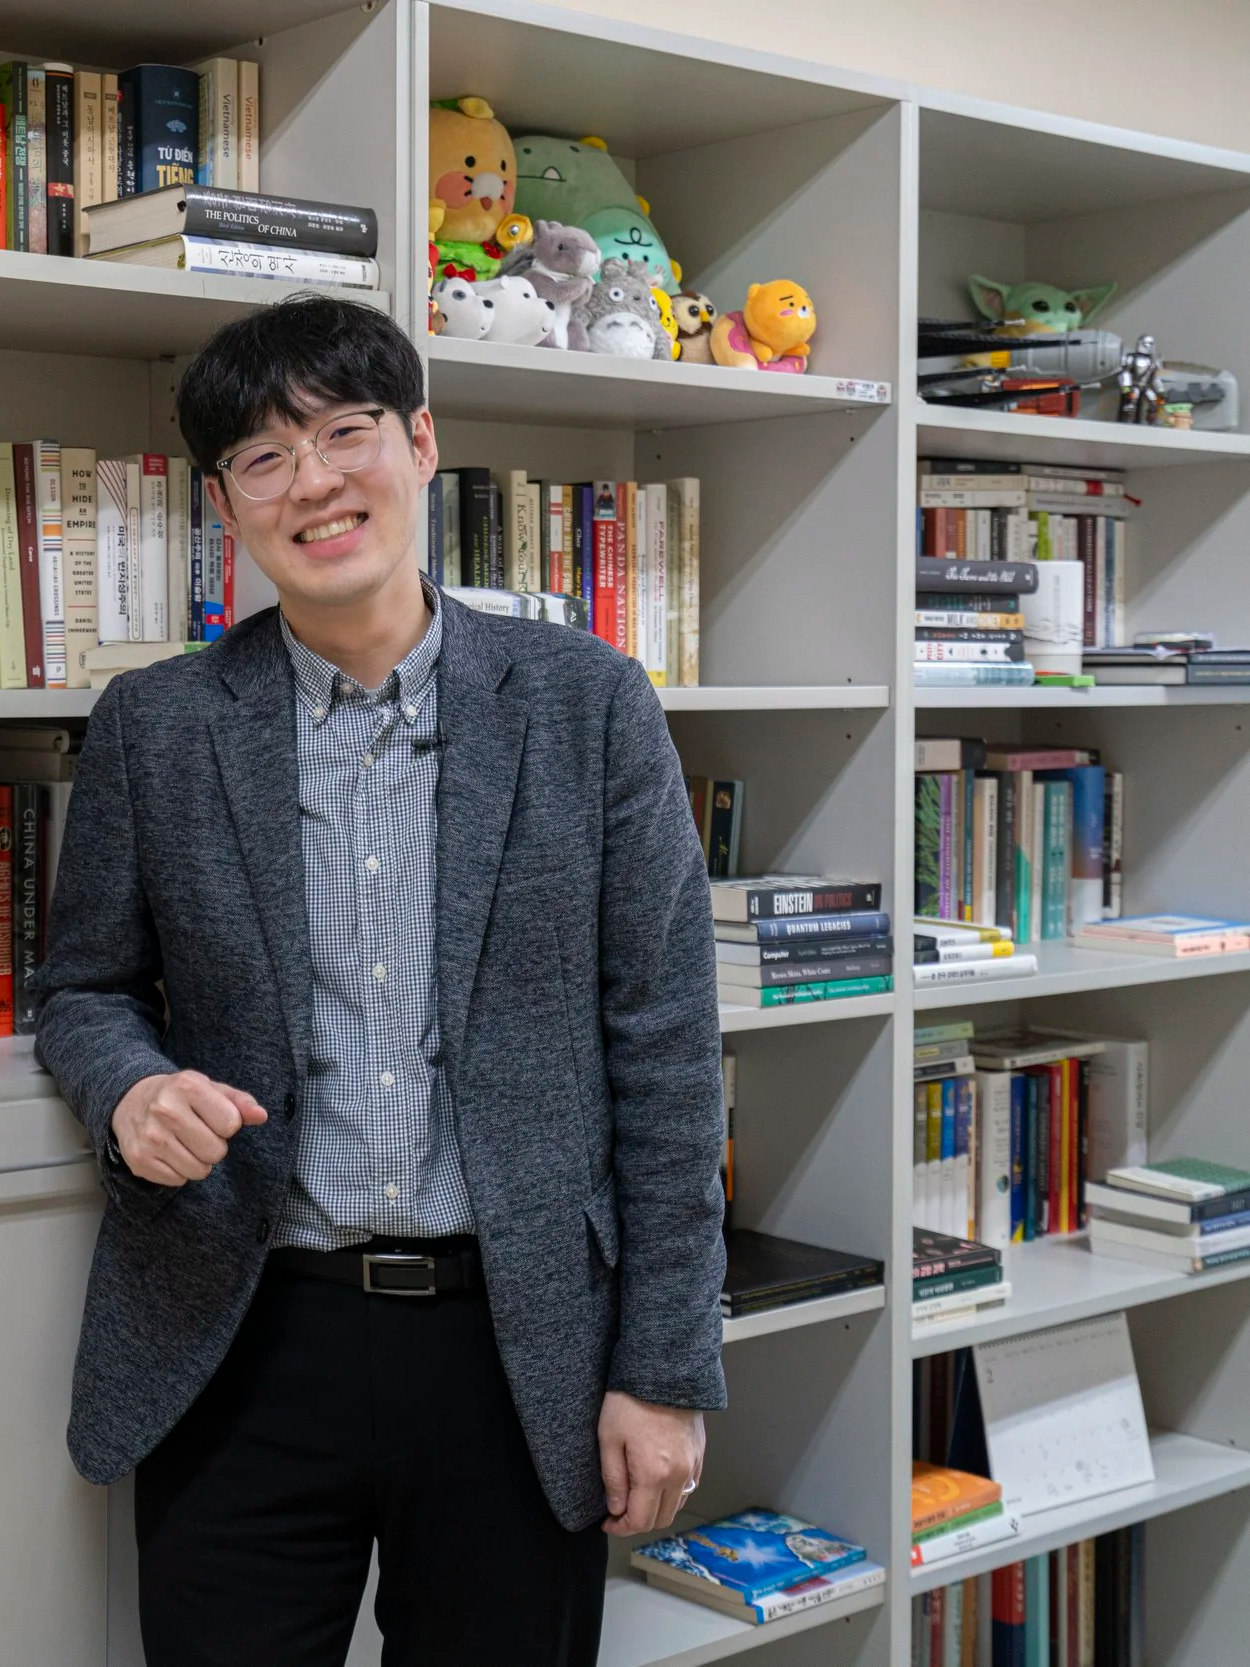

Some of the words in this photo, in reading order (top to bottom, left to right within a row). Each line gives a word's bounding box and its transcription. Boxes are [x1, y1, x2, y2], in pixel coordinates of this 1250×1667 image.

[245, 97, 253, 160] Vietnamese
[205, 209, 221, 219] THE
[223, 212, 259, 224] POLITICS
[258, 225, 268, 233] OF
[271, 226, 297, 237] CHINA
[72, 469, 92, 478] HOW
[72, 495, 93, 503] HIDE
[67, 520, 96, 529] EMPIRE
[616, 522, 626, 572] PANDA
[598, 525, 606, 589] TYPEWRITER
[616, 577, 627, 649] NATION
[786, 923, 820, 936] QUANTUM
[821, 920, 852, 932] LEGACIES
[763, 951, 790, 961] Computer
